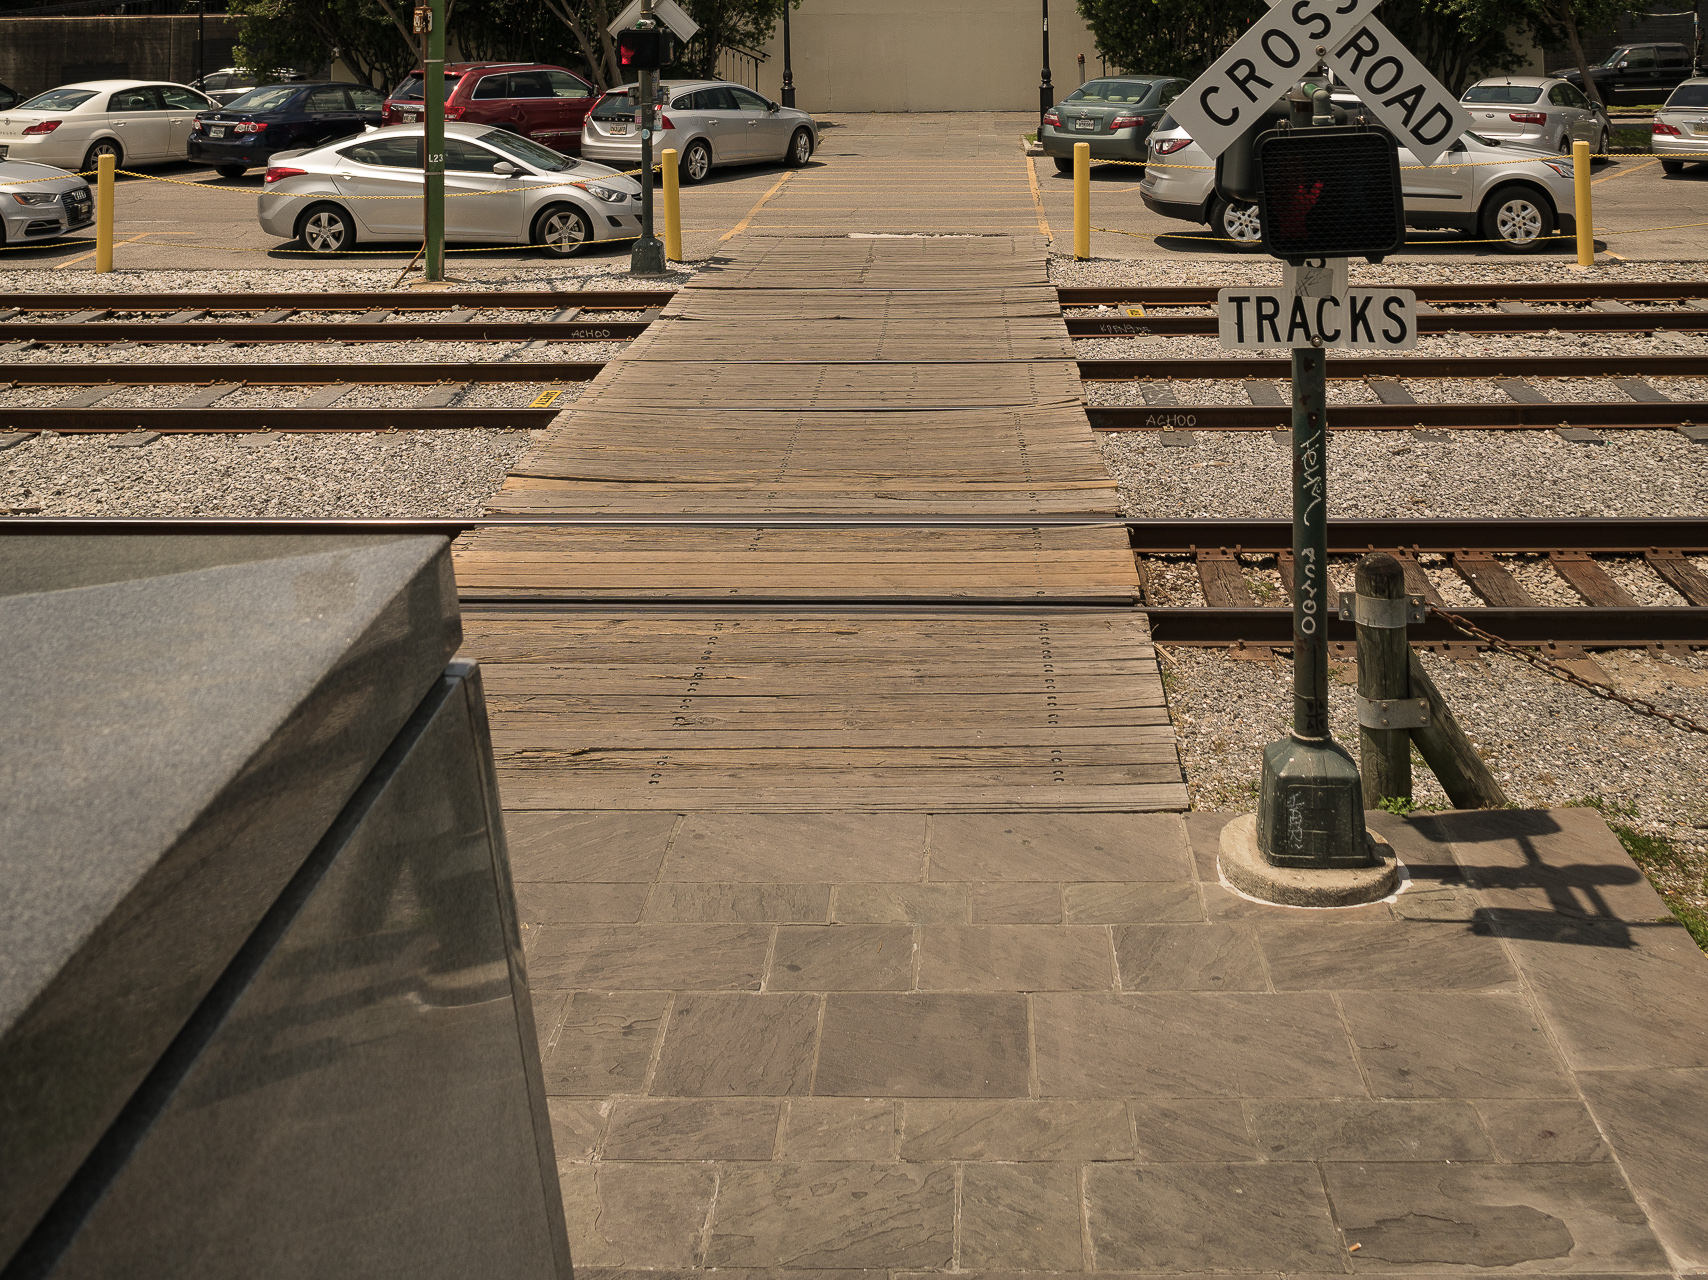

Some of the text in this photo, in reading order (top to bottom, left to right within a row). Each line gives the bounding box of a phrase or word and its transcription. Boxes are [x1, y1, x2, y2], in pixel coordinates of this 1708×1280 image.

[1335, 25, 1454, 146] ROAD
[428, 153, 444, 163] L23
[1228, 295, 1407, 344] TRACKS
[571, 329, 611, 338] ACHOO
[1146, 414, 1197, 427] ACHOO
